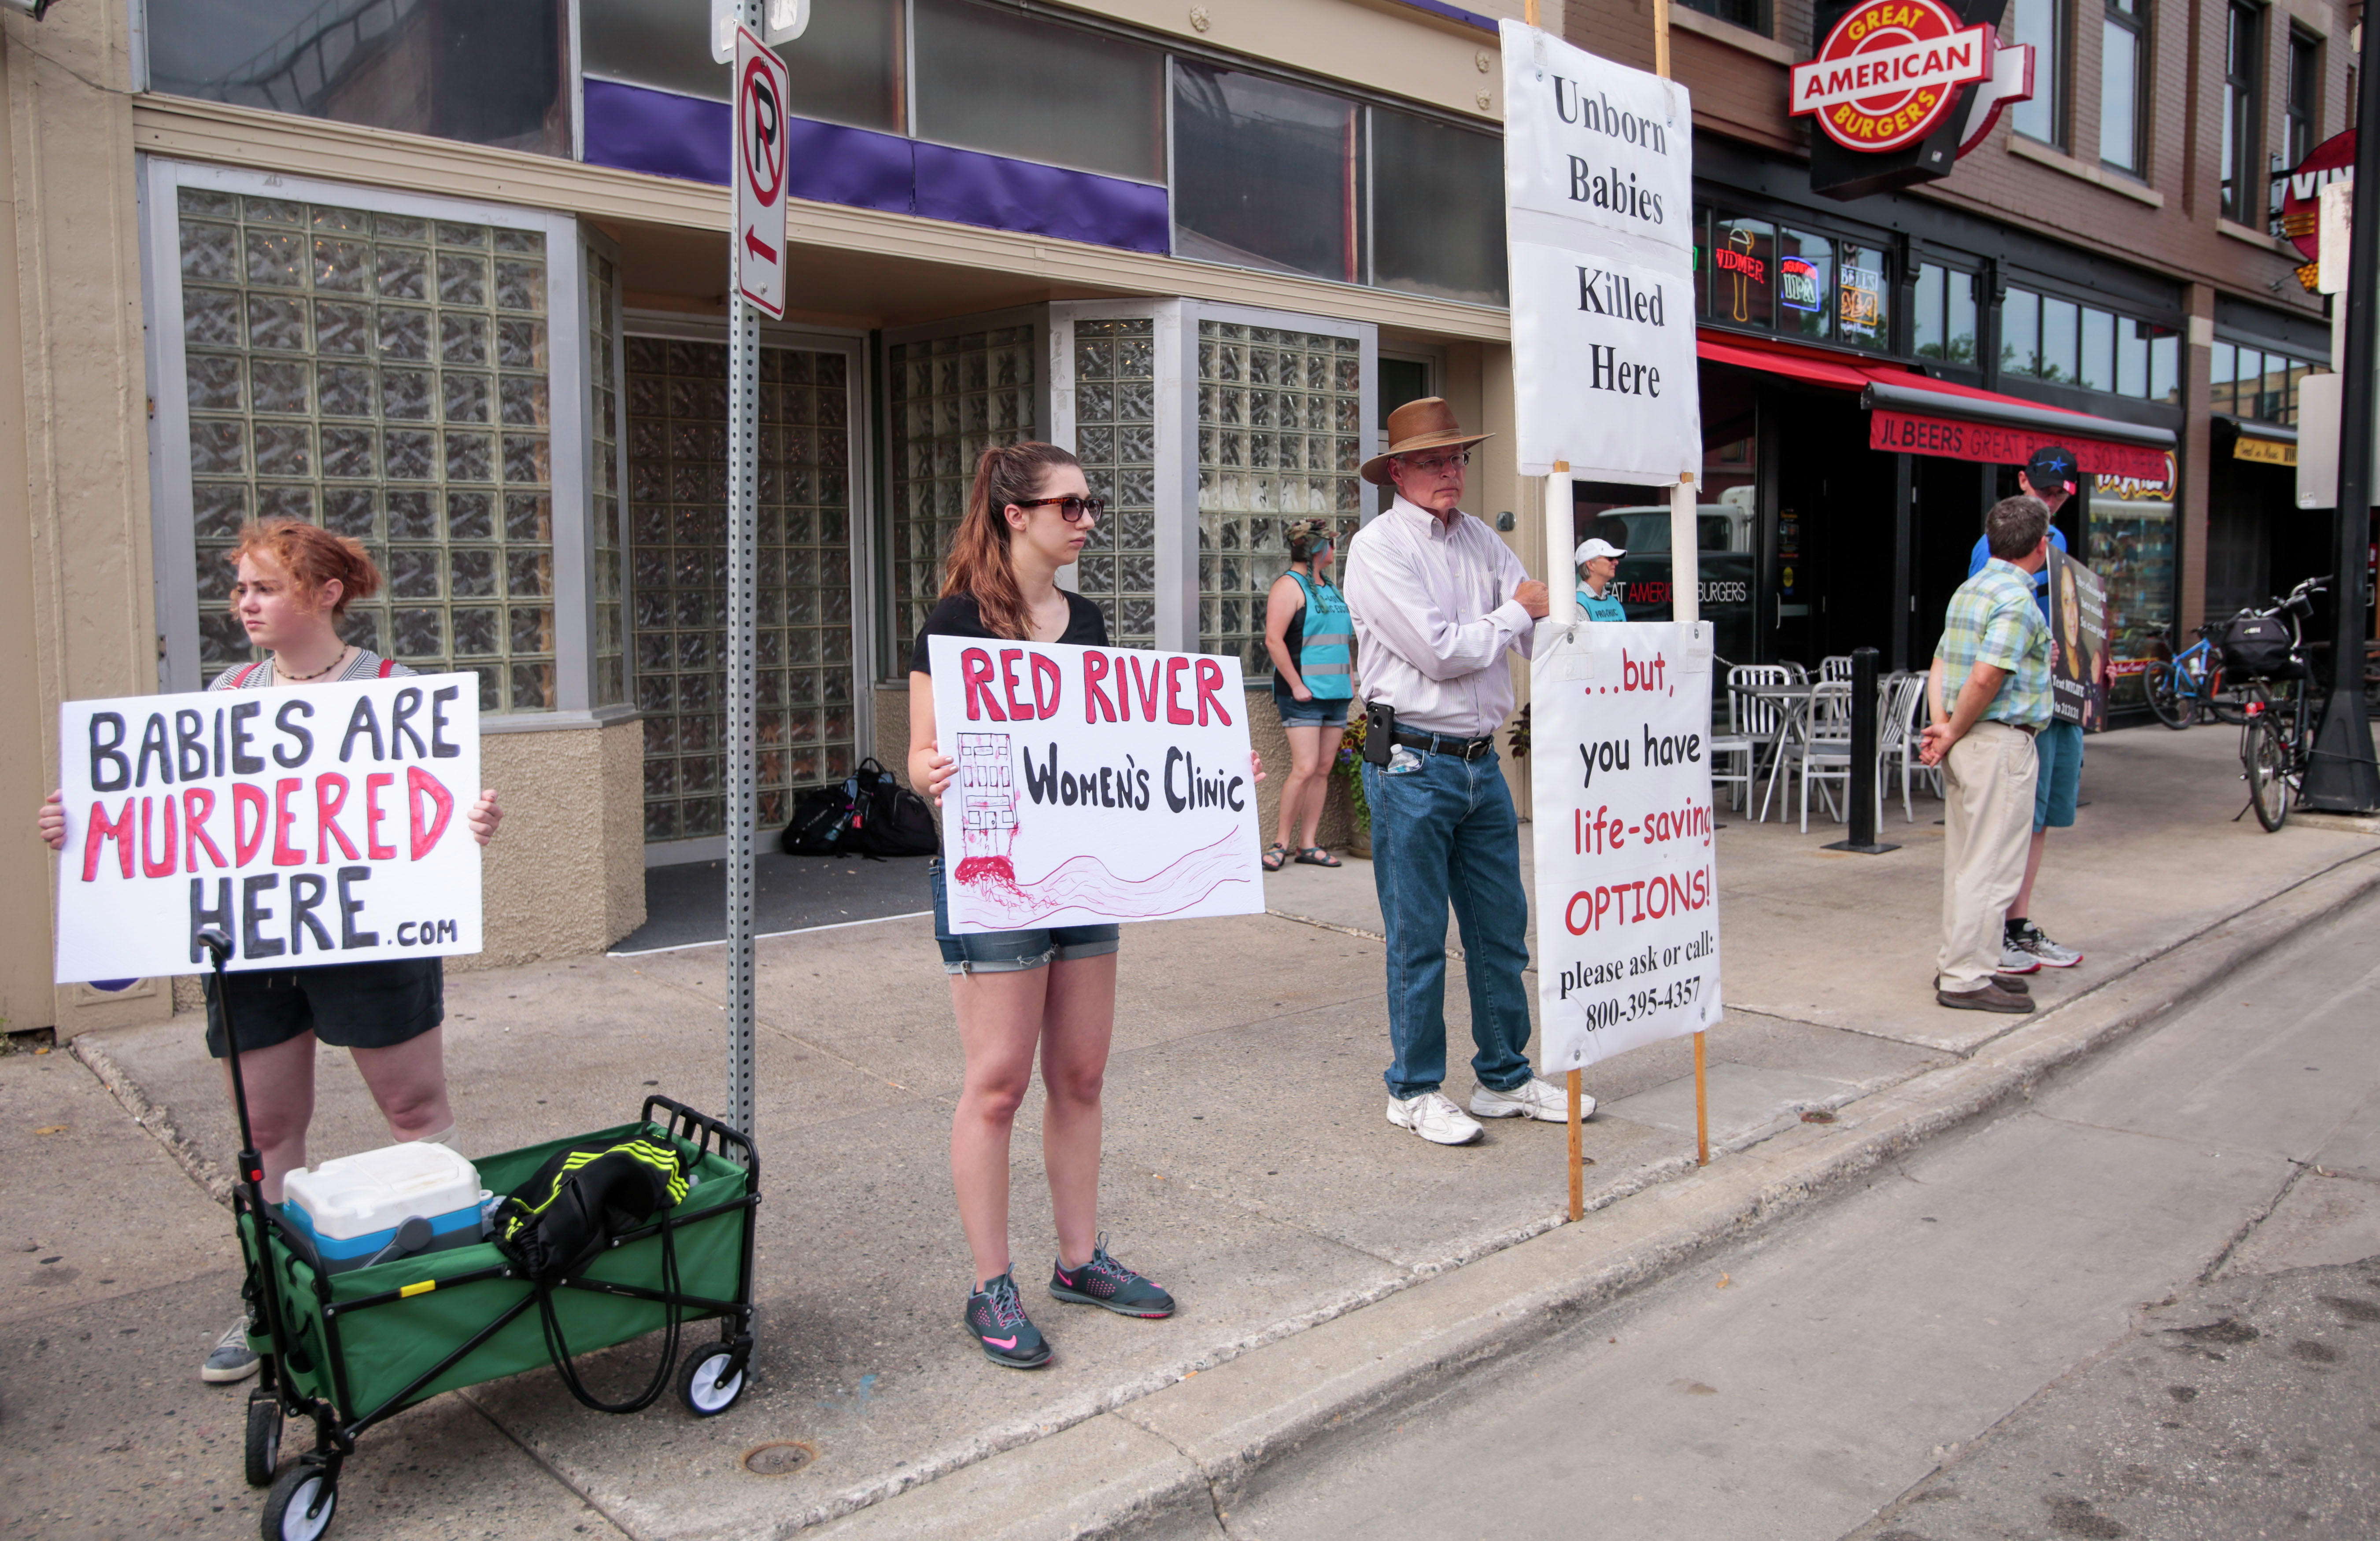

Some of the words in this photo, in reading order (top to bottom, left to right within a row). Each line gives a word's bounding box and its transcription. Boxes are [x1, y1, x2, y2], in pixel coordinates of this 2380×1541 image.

[1848, 5, 1925, 41] GREAT
[1804, 43, 1970, 100] AMERICAN
[1551, 74, 1667, 156] Unborn
[1833, 89, 1936, 139] BURGERS
[1566, 153, 1663, 225] Babies
[1574, 265, 1665, 327] Killed
[1588, 343, 1661, 398] Here
[1901, 419, 1963, 453] BEERS
[1970, 429, 2020, 460] GREAT
[1628, 581, 1673, 603] AMERIC
[1698, 581, 1746, 602] BURGERS
[961, 647, 1061, 722] RED
[1083, 650, 1232, 726] RIVER
[90, 699, 315, 792] BABIES
[339, 685, 461, 763] ARE
[1579, 737, 1630, 789] you
[1643, 723, 1701, 767] have
[81, 765, 454, 882] MURDERED
[1574, 796, 1711, 855] life-saving
[1565, 864, 1711, 936] OPTIONS!
[1560, 961, 1624, 999] please
[1629, 944, 1659, 975] ask
[1663, 943, 1681, 967] or
[1685, 929, 1714, 962] call:
[1586, 975, 1701, 1032] 800-395-4357
